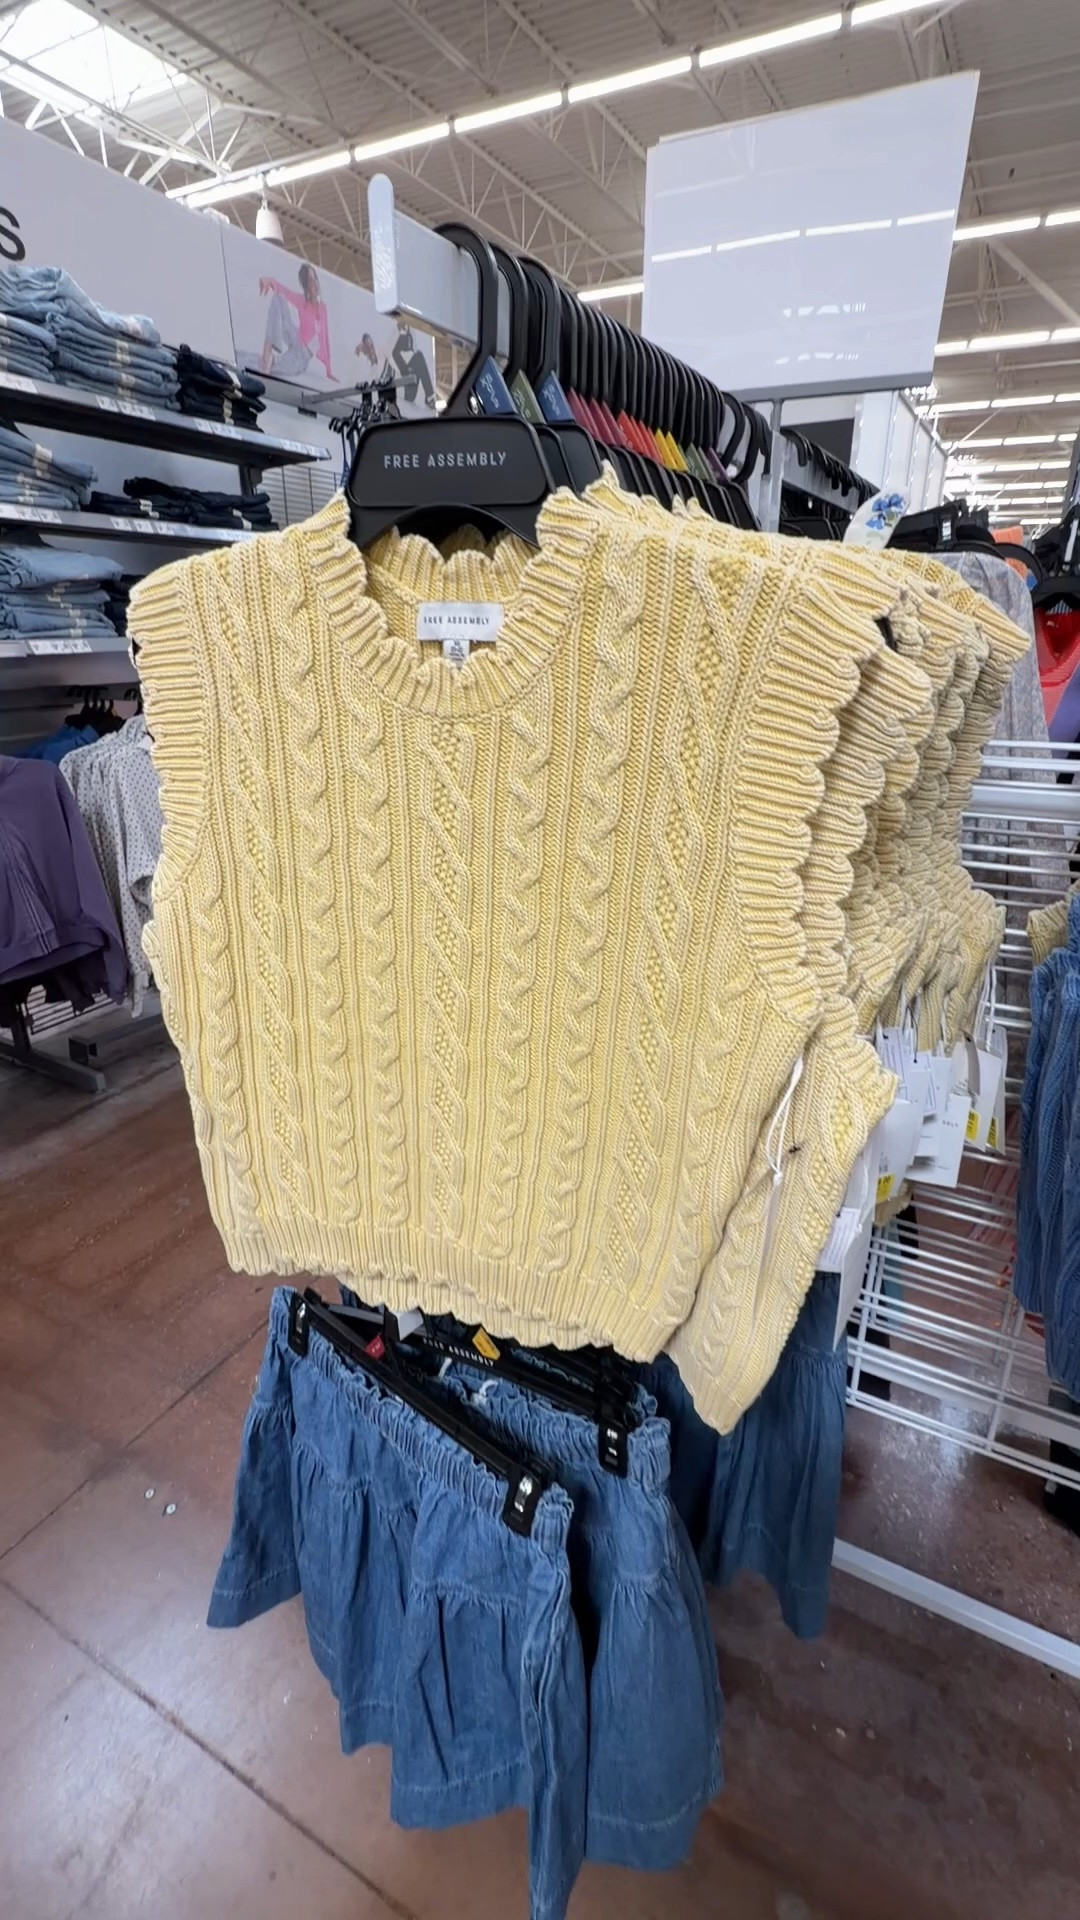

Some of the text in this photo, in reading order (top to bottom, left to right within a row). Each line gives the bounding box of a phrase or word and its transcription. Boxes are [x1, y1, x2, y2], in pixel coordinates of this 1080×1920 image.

[383, 451, 507, 469] FREE ASSEMBLY
[447, 615, 490, 625] ASSEMBLY
[448, 1344, 495, 1368] ASSEMBLY
